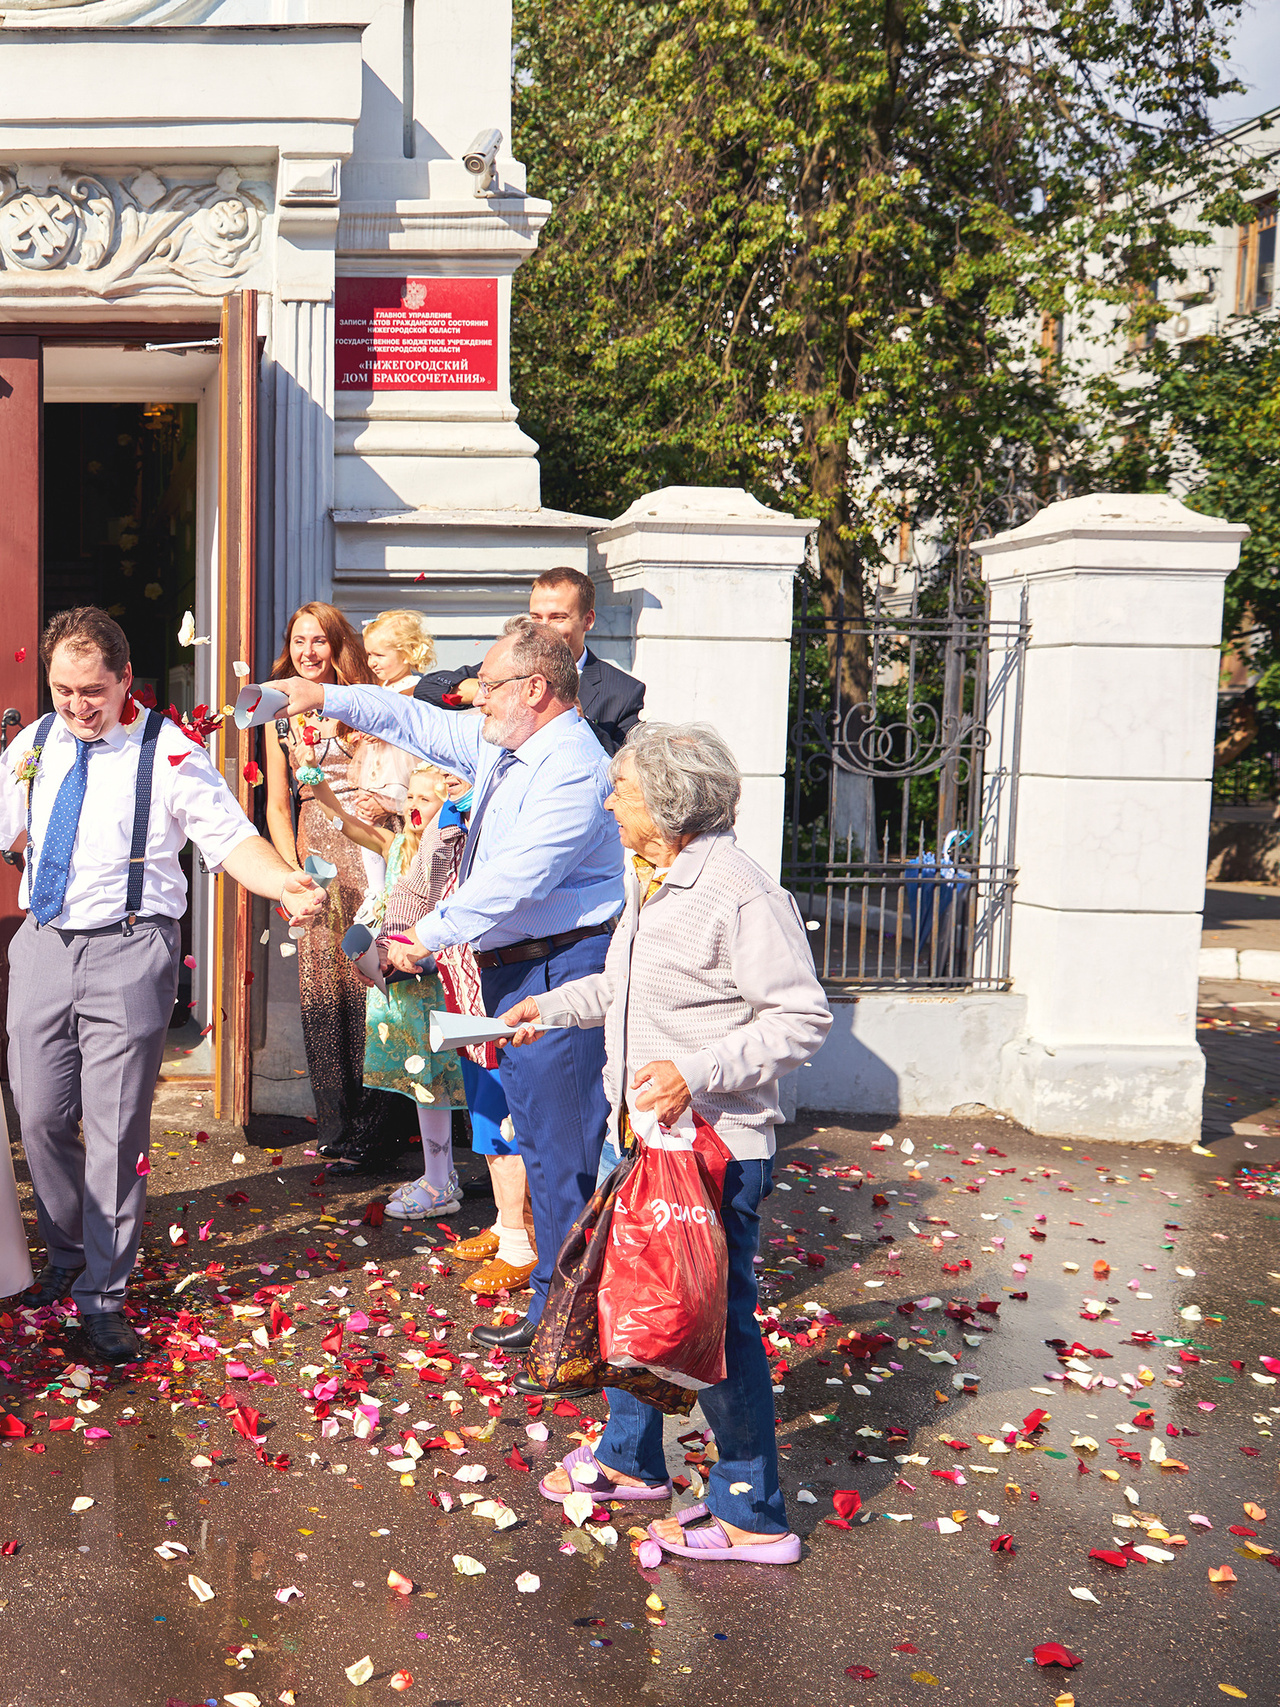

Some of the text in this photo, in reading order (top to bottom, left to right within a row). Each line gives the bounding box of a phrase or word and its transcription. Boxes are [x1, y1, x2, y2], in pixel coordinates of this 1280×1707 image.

[368, 345, 427, 353] НИЖЕГОРОДСКОЙ
[359, 358, 468, 372] «НИЖЕГОРОДСКИЙ
[342, 373, 486, 384] ДОМ БРАКОСОЧЕТАНИЯ»
